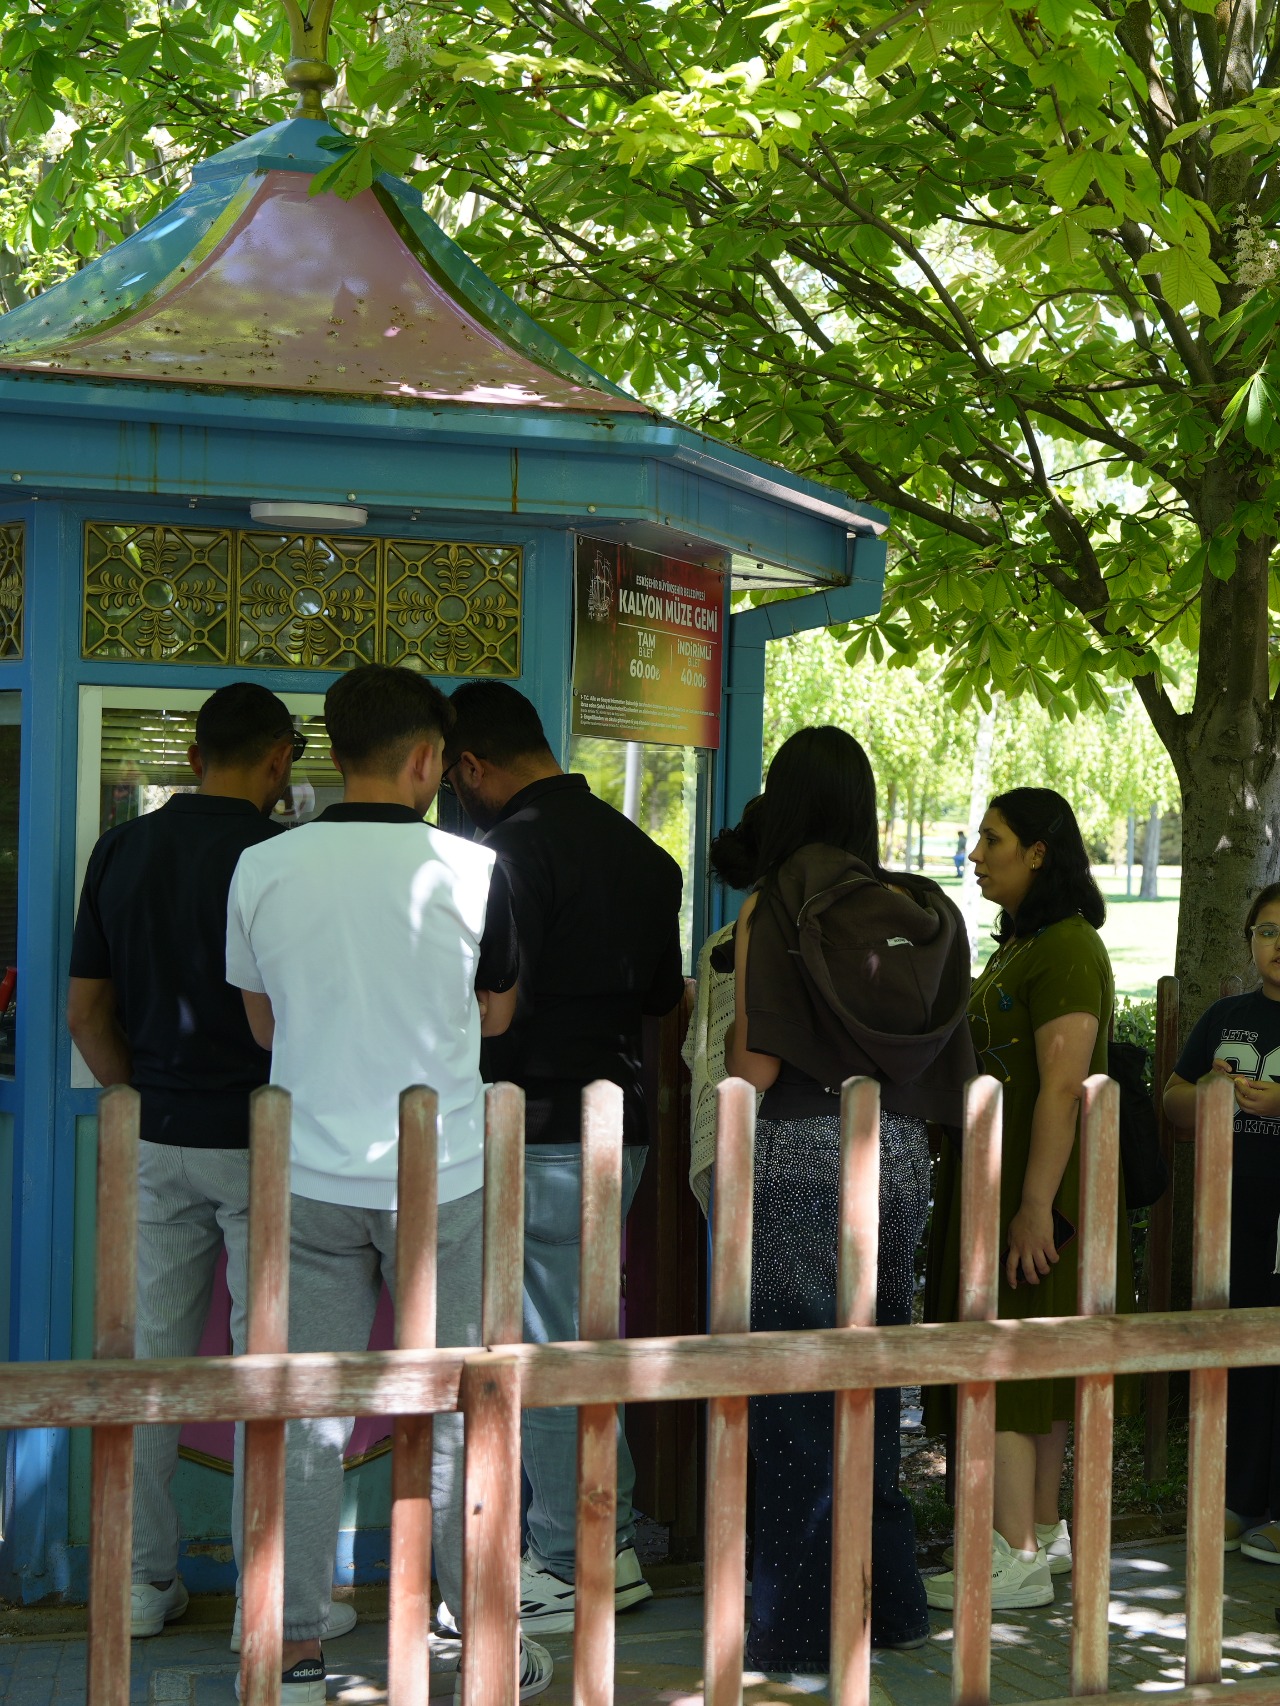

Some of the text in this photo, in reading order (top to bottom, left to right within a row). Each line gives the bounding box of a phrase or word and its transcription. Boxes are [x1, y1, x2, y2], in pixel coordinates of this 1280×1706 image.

[619, 588, 718, 632] KALYON MÜZE GEMİ
[637, 631, 656, 649] TAM
[638, 646, 654, 659] BİLET
[677, 638, 712, 661] İNDİRİMLİ
[1220, 1028, 1259, 1043] LET'S
[292, 1668, 323, 1677] adidas
